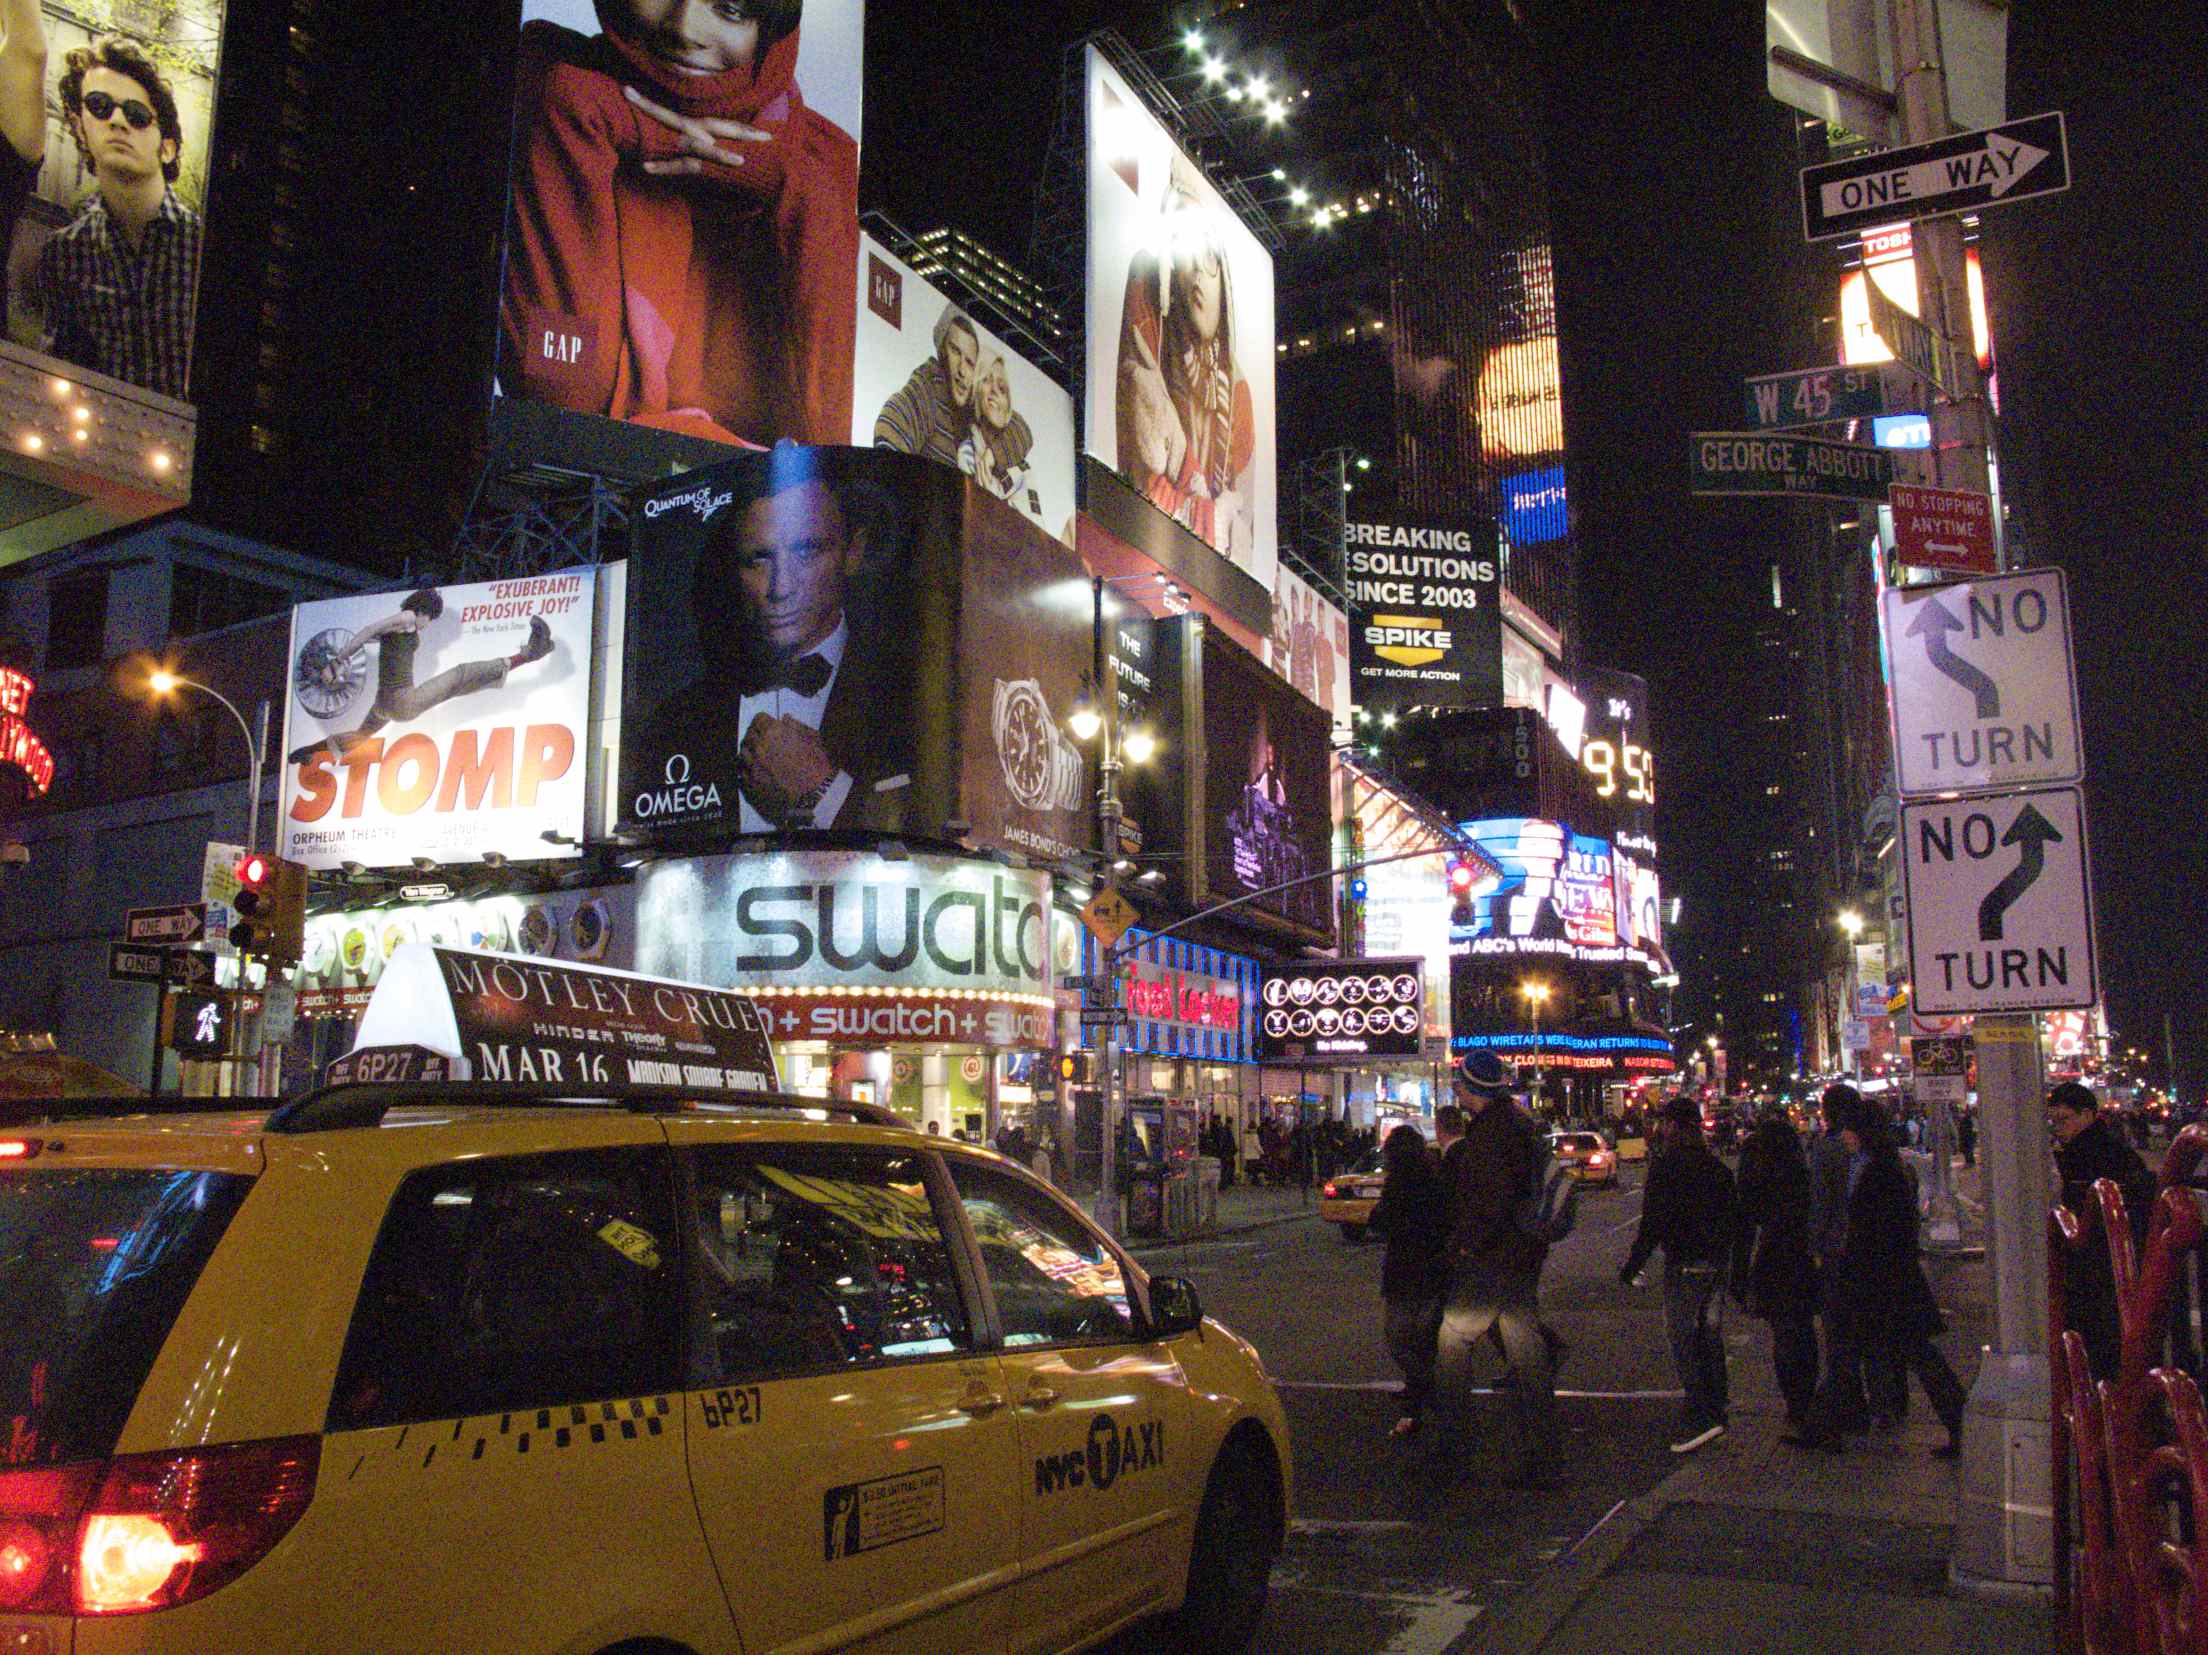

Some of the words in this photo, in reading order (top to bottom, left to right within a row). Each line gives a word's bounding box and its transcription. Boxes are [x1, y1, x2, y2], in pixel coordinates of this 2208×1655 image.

[1841, 171, 1911, 209] ONE
[1945, 146, 2022, 188] WAY
[876, 275, 895, 307] GAP
[544, 330, 582, 363] GAP
[1755, 383, 1778, 423] W
[1794, 375, 1831, 417] 45
[1844, 373, 1868, 392] ST
[1701, 440, 1796, 473] GEORGE
[1807, 447, 1886, 481] ABBOTT
[645, 493, 696, 518] QUANTUM
[697, 487, 711, 500] OF
[693, 492, 733, 513] SOLACE
[1897, 493, 1914, 508] NO
[1922, 496, 1984, 516] STOPPING
[1345, 523, 1471, 552] BREAKING
[1911, 519, 1977, 538] ANYTIME
[1346, 580, 1415, 605] SINCE
[1421, 586, 1477, 608] 2003
[461, 600, 532, 623] EXPLOSIVE
[1968, 588, 2048, 641] NO
[1120, 630, 1140, 657] THE
[1365, 627, 1452, 649] SPIKE
[1109, 654, 1150, 693] FUTURE
[1361, 667, 1382, 676] GET
[1385, 669, 1418, 678] MORE
[1420, 671, 1460, 681] ACTION
[1921, 721, 2055, 770] TURN
[290, 723, 574, 822] STOMP
[635, 782, 721, 817] OMEGA
[292, 829, 346, 846] ORPHEUM
[1004, 824, 1028, 849] JAMES
[1118, 823, 1143, 845] SPIKE
[1919, 812, 1996, 864] NO
[139, 919, 160, 935] ONE
[171, 917, 193, 932] WAY
[1472, 938, 1516, 953] ABC's
[1518, 938, 1554, 952] World
[1578, 946, 1624, 960] Trusted
[125, 956, 157, 973] ONE
[1935, 946, 2068, 991] TURN
[449, 957, 635, 1016] MÖTLEY
[655, 987, 759, 1032] CRÜE
[533, 1022, 615, 1043] HINDER
[810, 1003, 955, 1036] swatch
[1459, 1036, 1488, 1048] BLAGO
[357, 1053, 412, 1082] 6P27
[478, 1043, 562, 1082] MAR
[576, 1051, 609, 1082] 16
[627, 1058, 682, 1086] MADISON
[683, 1065, 724, 1089] SQUARE
[725, 1069, 768, 1091] GARDEN
[1573, 1056, 1613, 1068] TEIXEIRA
[701, 1387, 761, 1429] 6P27
[1036, 1450, 1085, 1495] NYC
